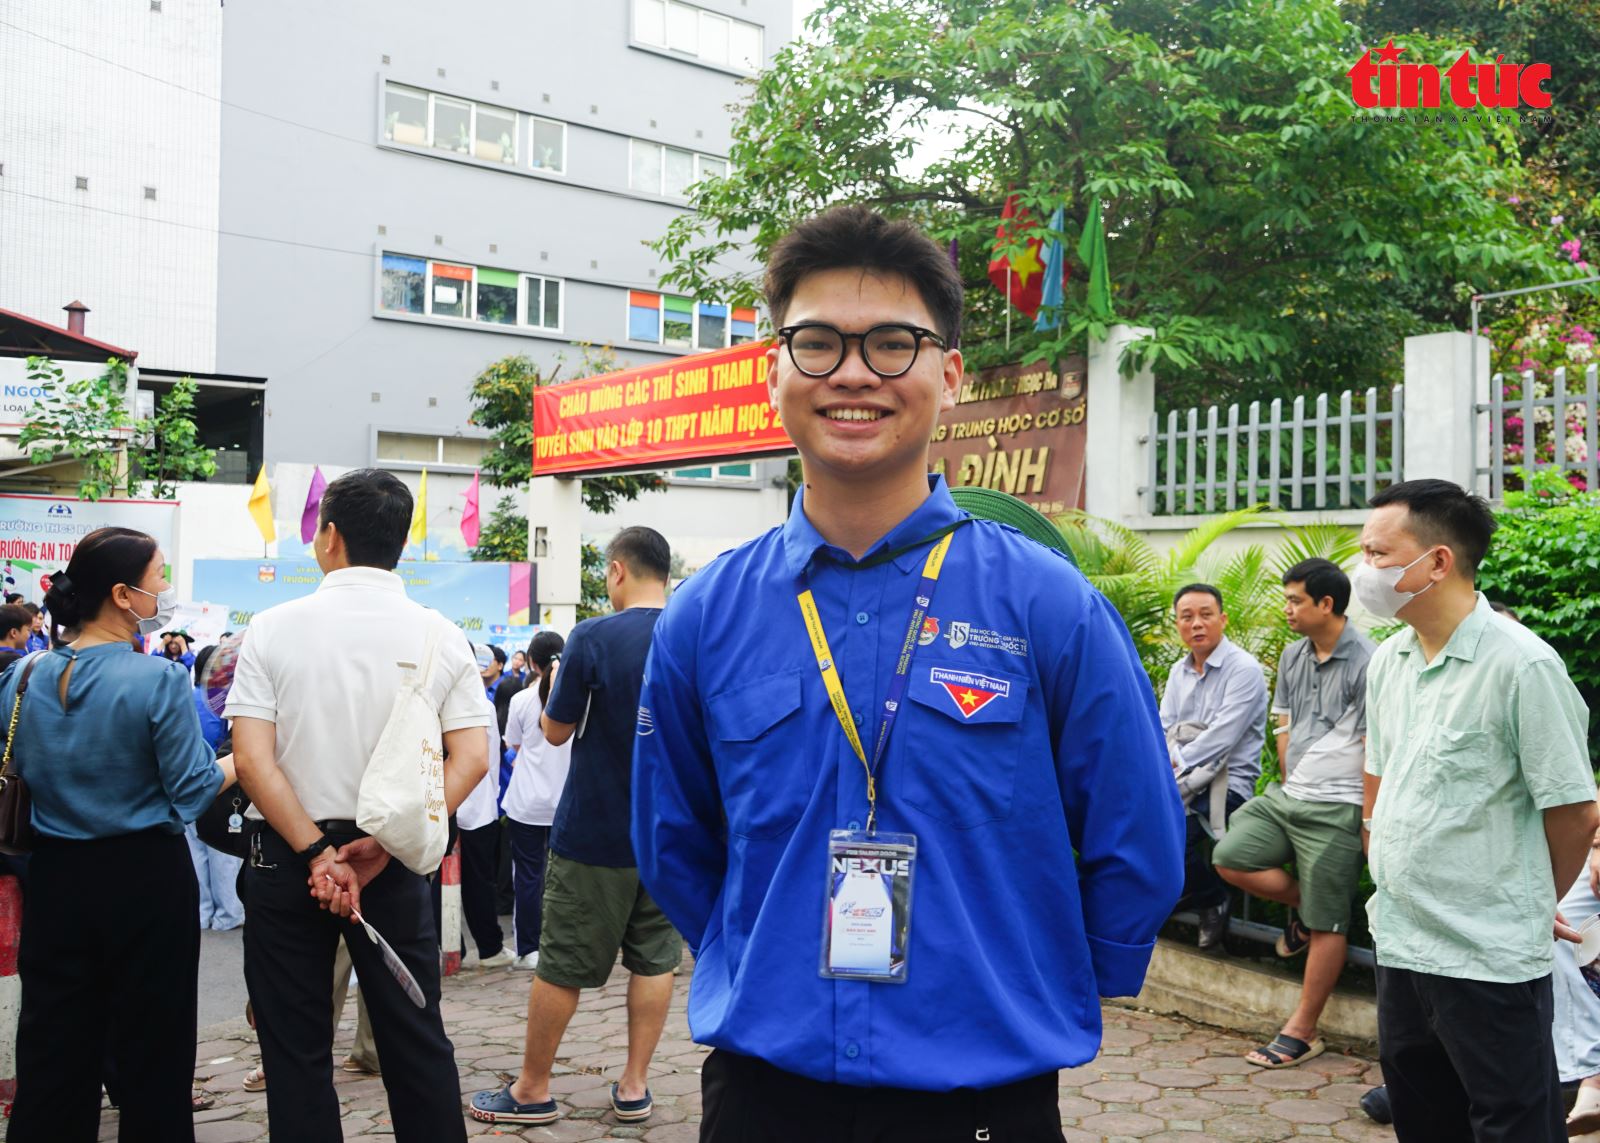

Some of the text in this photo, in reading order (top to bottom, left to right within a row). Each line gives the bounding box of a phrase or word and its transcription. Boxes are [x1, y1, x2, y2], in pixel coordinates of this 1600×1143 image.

[559, 355, 767, 419] CHÀO MỪNG CÁC THÍ SINH THAM D
[568, 429, 594, 454] SINH
[595, 422, 618, 450] VÀO
[620, 418, 643, 447] LỚP
[646, 418, 663, 444] 10
[664, 412, 698, 442] THPT
[699, 404, 735, 437] NĂM
[737, 402, 770, 437] HỌC
[951, 418, 996, 440] TRUNG
[998, 412, 1033, 438] HỌC
[1035, 407, 1061, 428] CƠ
[1063, 396, 1086, 425] SỞ
[956, 435, 1049, 495] ĐÌNH
[0, 520, 43, 532] RƯỜNG
[0, 536, 77, 562] RƯỜNG AN TO
[969, 633, 1000, 645] TRƯỜNG
[934, 671, 1007, 692] THANH NIÊN VIỆT NAM
[832, 857, 909, 877] NEXUS
